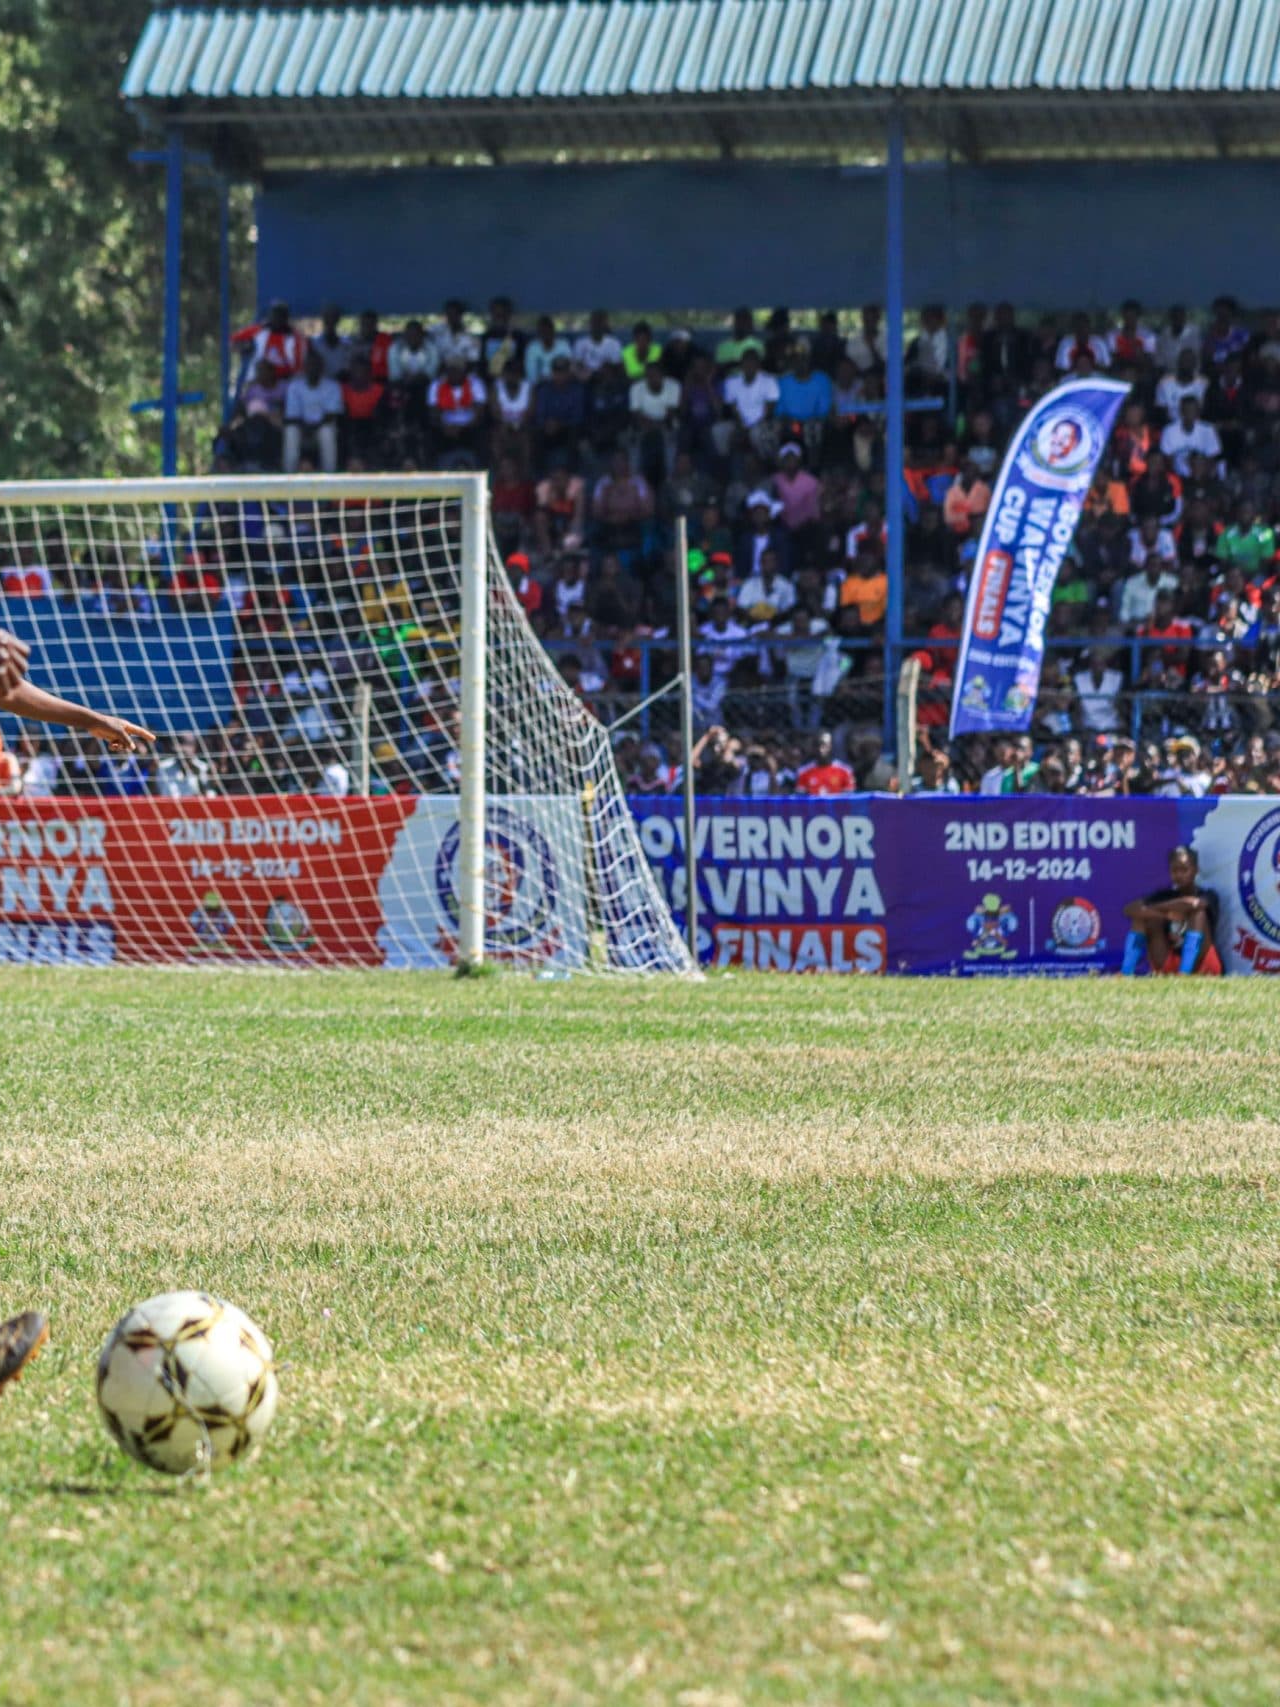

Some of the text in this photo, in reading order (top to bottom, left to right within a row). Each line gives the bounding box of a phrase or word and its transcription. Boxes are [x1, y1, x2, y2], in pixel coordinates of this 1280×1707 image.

[994, 485, 1027, 545] CUP
[998, 496, 1058, 649] WAVINYA
[1023, 500, 1082, 652] GOVERNOR
[170, 818, 342, 846] 2ND EDITION
[639, 816, 875, 859] OVERNOR
[945, 820, 1136, 851] 2ND EDITION
[191, 857, 301, 878] 14-12-2024
[967, 858, 1092, 882] 14-12-2024
[716, 929, 882, 972] FINALS
